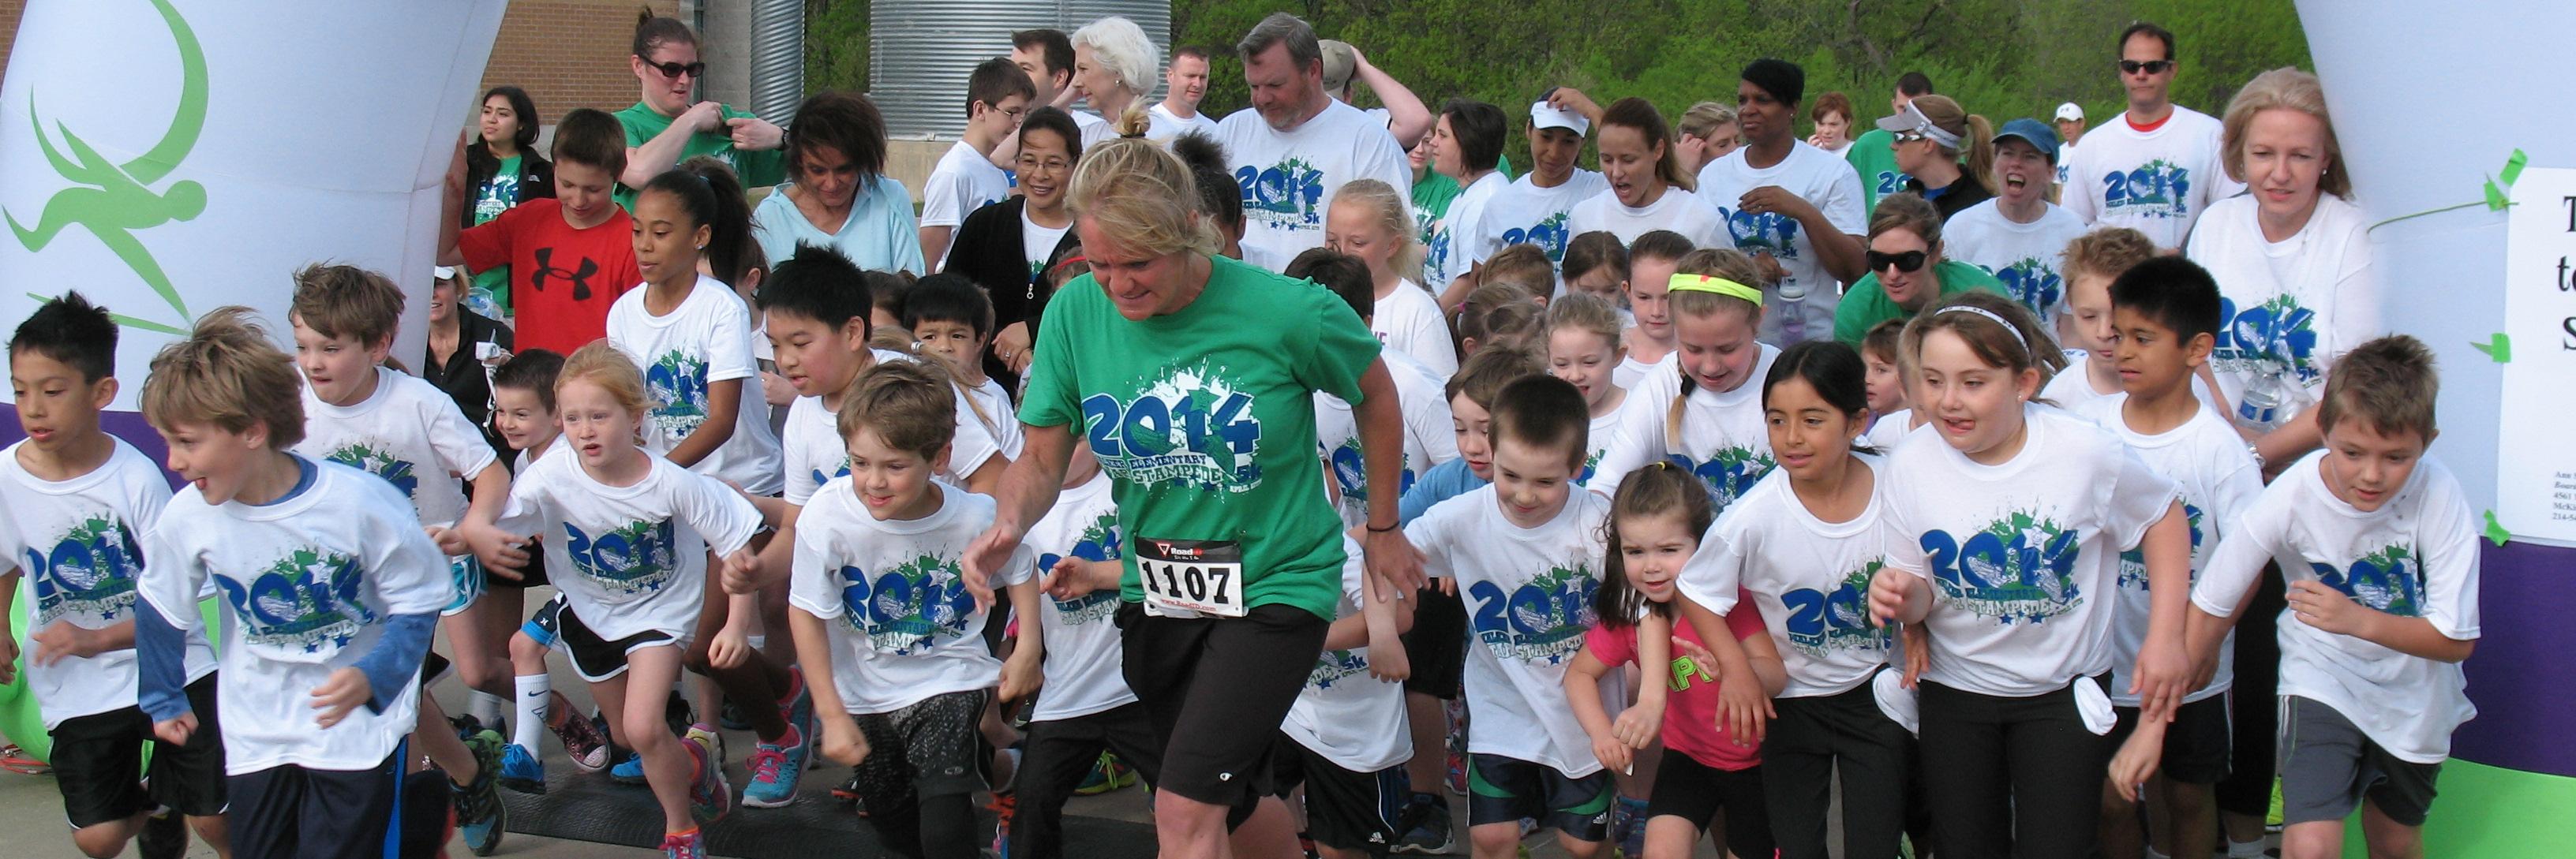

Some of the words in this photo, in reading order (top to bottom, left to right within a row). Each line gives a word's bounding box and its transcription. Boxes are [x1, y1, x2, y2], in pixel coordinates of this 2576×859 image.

[1235, 166, 1324, 204] 2014
[2103, 166, 2190, 200] 2014
[1081, 393, 1261, 458] 2014
[1129, 454, 1207, 470] ELEMENTARY
[1132, 464, 1222, 484] STAMPEDE
[1919, 529, 2080, 588] 2014
[1142, 561, 1230, 604] 1107
[1780, 583, 1861, 636] 20
[1968, 597, 2052, 618] STAMPEDE
